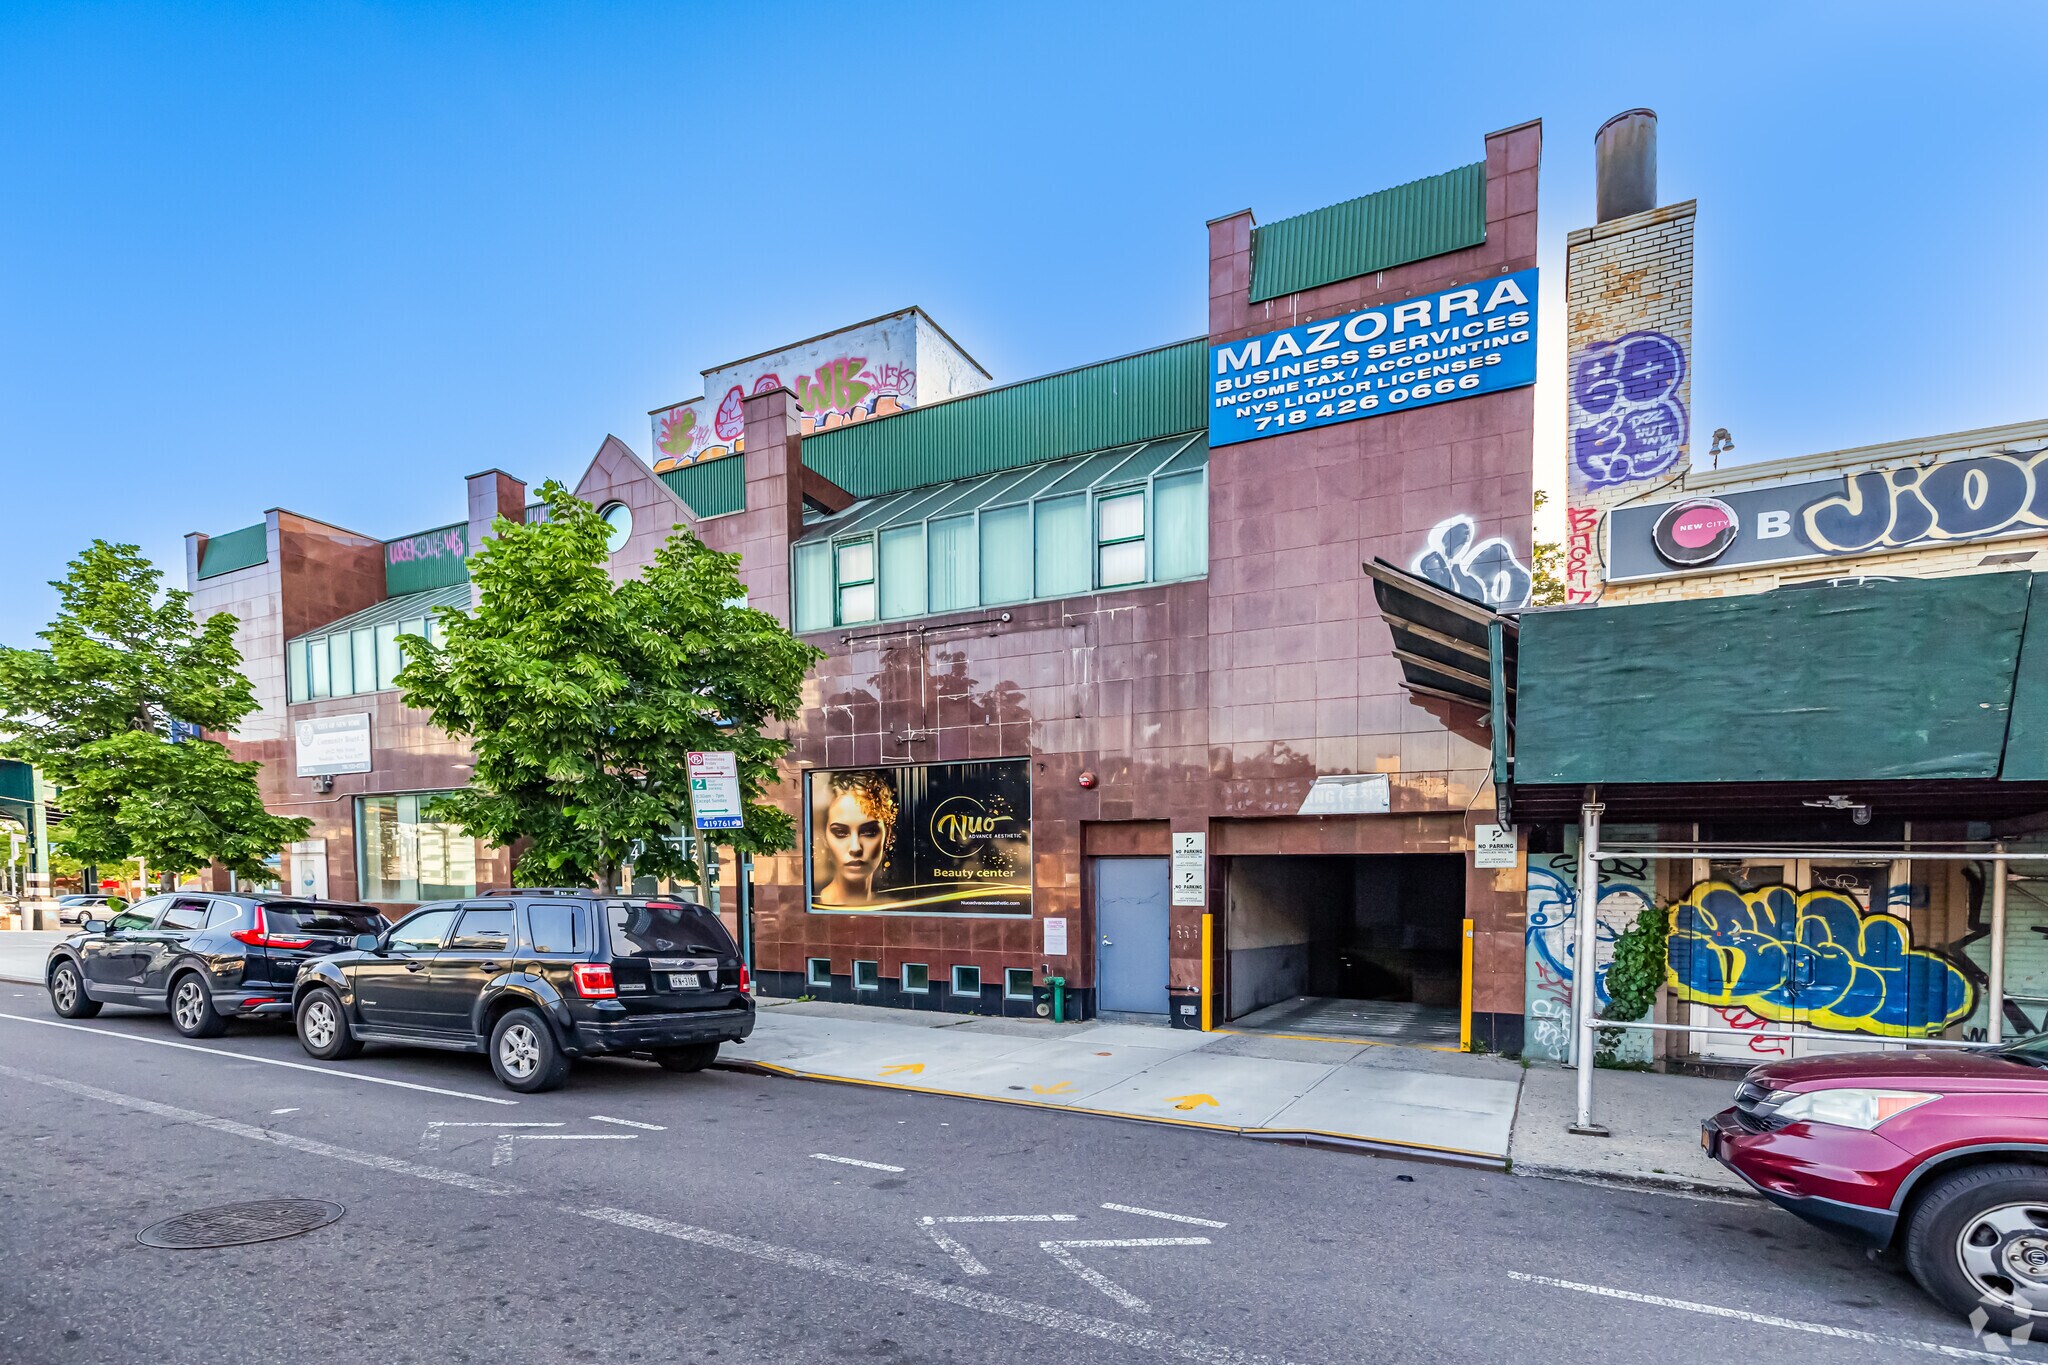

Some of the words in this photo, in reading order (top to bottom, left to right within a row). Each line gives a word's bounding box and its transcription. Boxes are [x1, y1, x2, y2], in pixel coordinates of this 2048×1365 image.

[1217, 278, 1529, 375] MAZORRA
[1215, 349, 1360, 394] BUSINESS
[1367, 311, 1530, 360] SERVICES
[1215, 381, 1300, 408] INCOME
[1304, 370, 1346, 388] TAX
[1363, 330, 1529, 376] ACCOUNTING
[1235, 400, 1279, 419] NYS
[1284, 380, 1371, 409] LIQUOR
[1377, 352, 1502, 389] LICENSES
[1253, 409, 1307, 432] 718
[1315, 394, 1379, 419] 426
[1387, 373, 1481, 405] 0666
[1680, 523, 1702, 531] NEW
[1706, 520, 1729, 528] CITY
[695, 779, 703, 790] 2
[703, 820, 731, 828] 419761
[937, 814, 1013, 842] Nuo
[933, 868, 974, 880] Beauty
[976, 868, 1016, 878] center
